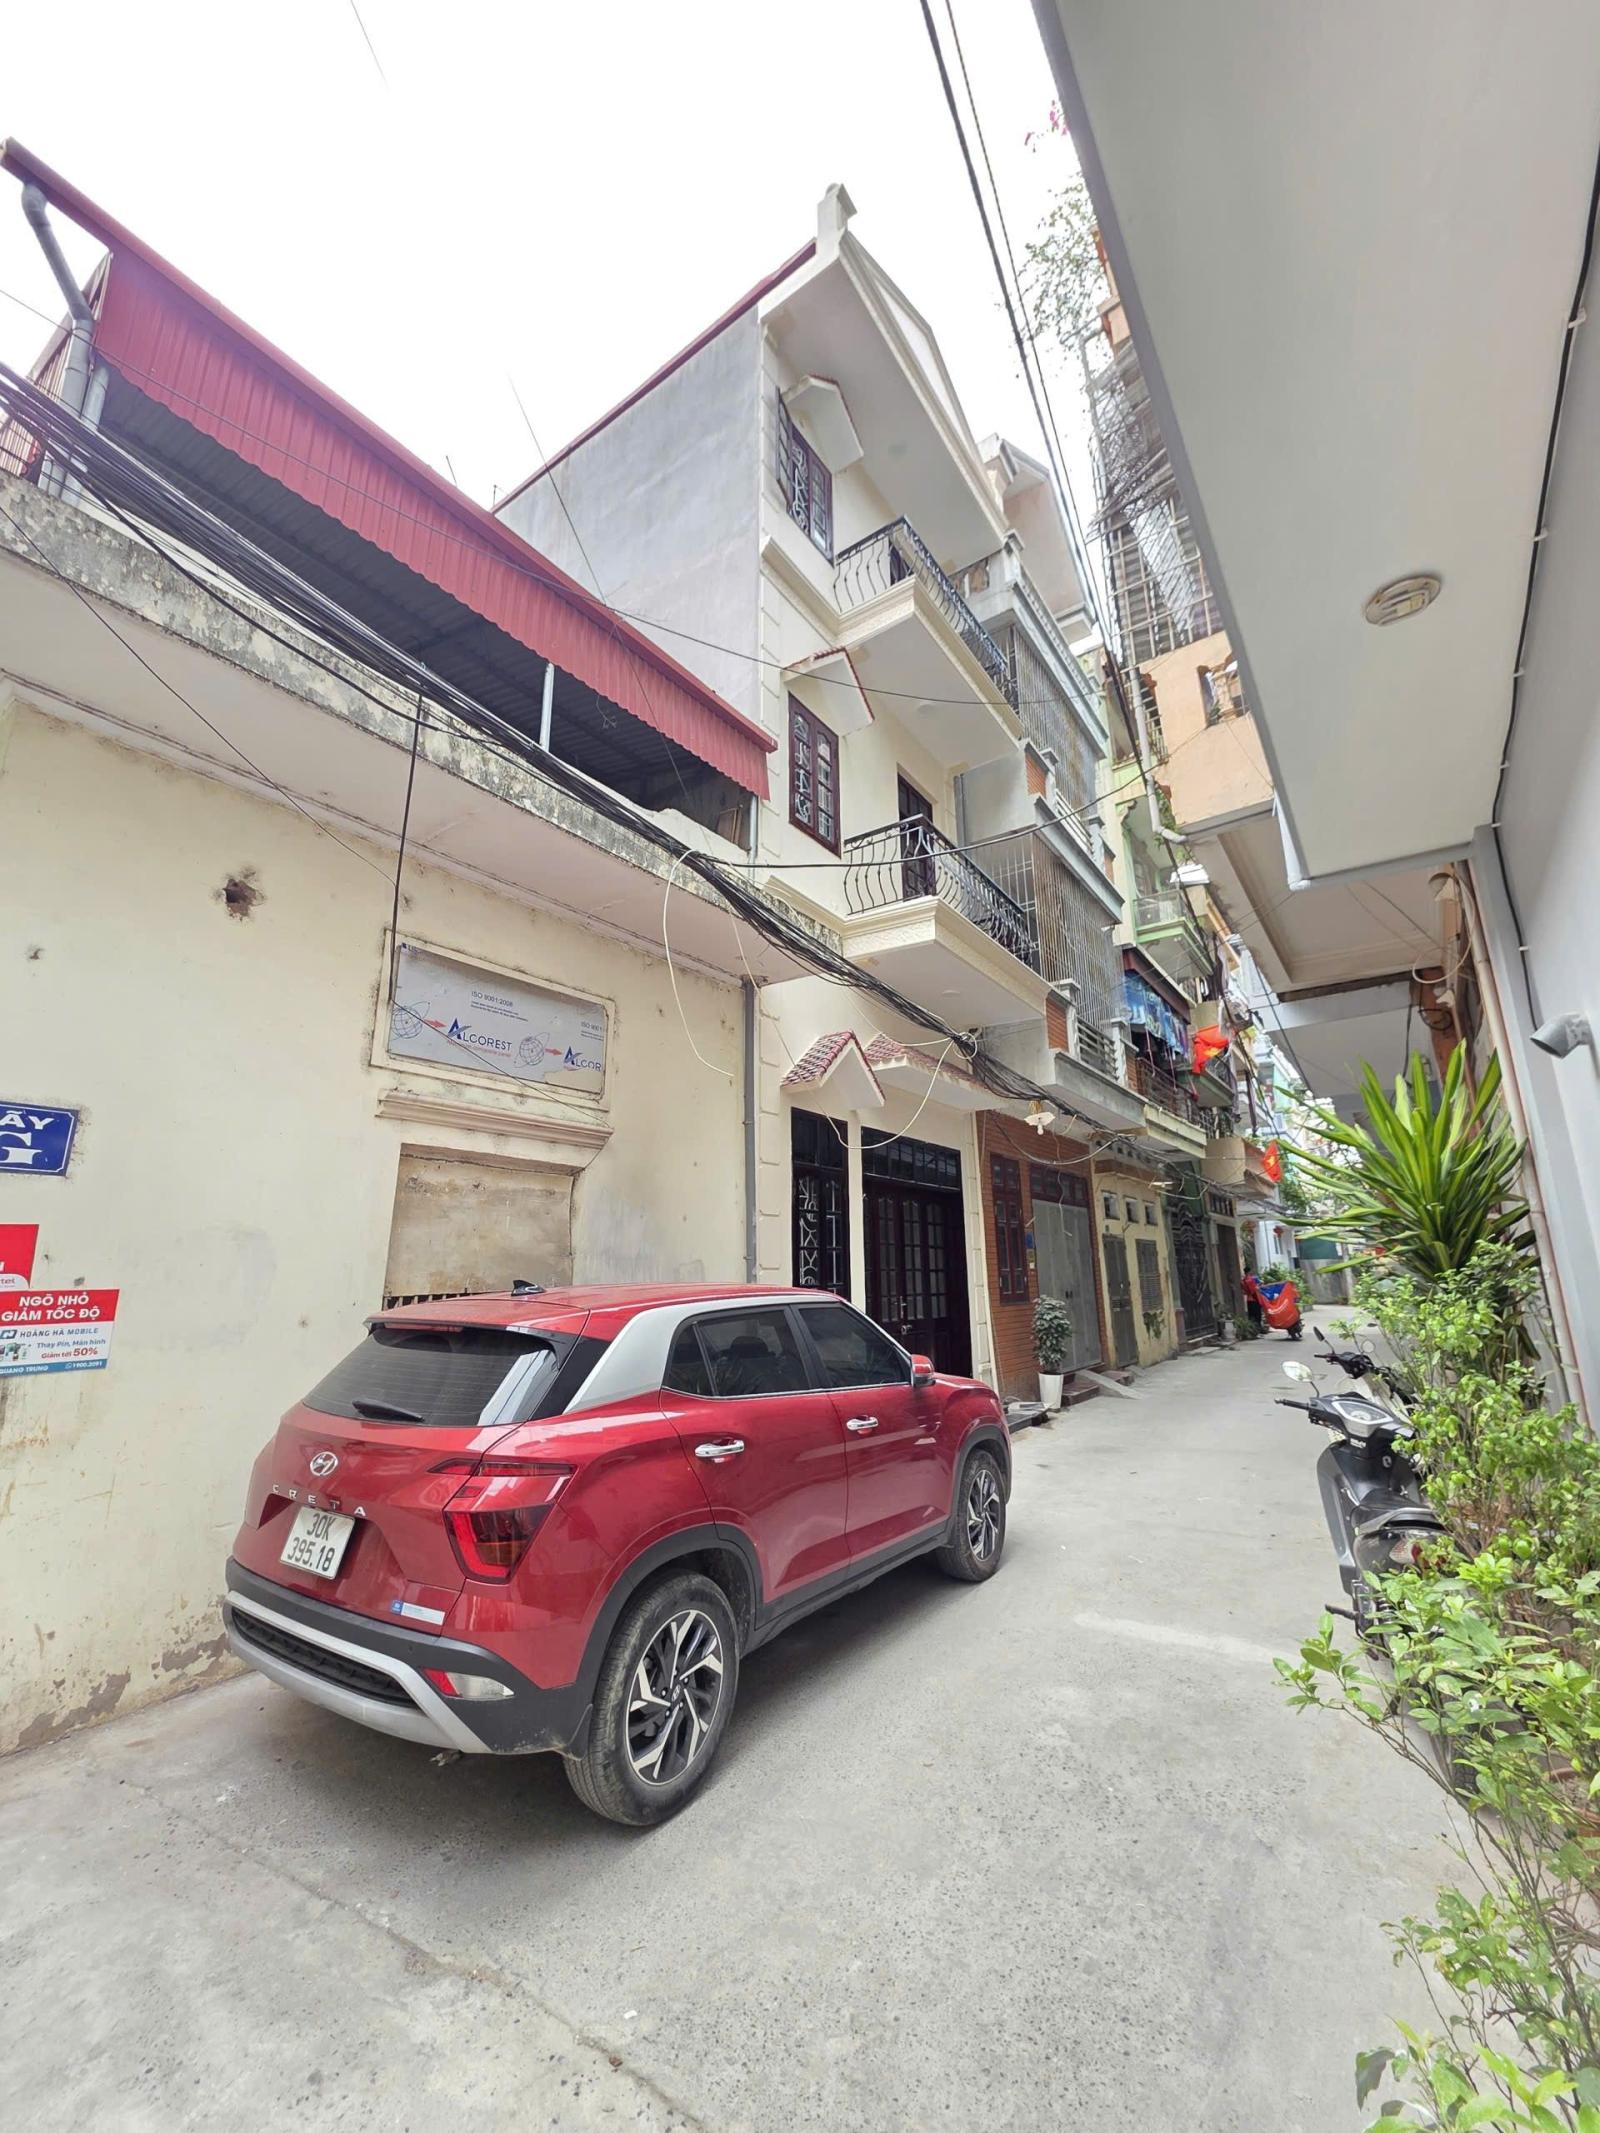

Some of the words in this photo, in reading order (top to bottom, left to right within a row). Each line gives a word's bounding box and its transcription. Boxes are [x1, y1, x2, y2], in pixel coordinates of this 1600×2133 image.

[447, 1018, 513, 1048] ALCOREST
[19, 1294, 54, 1307] NGÕ
[57, 1292, 89, 1305] NHỎ
[1, 1307, 42, 1322] GIẢM
[46, 1305, 76, 1320] TỐC
[79, 1306, 100, 1321] ĐỘ
[20, 1328, 50, 1338] HOÀNG
[52, 1327, 65, 1336] HÀ
[67, 1327, 99, 1335] MOBILE
[73, 1347, 99, 1357] 50%
[272, 1484, 367, 1517] CRETA
[306, 1512, 338, 1541] 30K
[287, 1536, 336, 1573] 395.18
